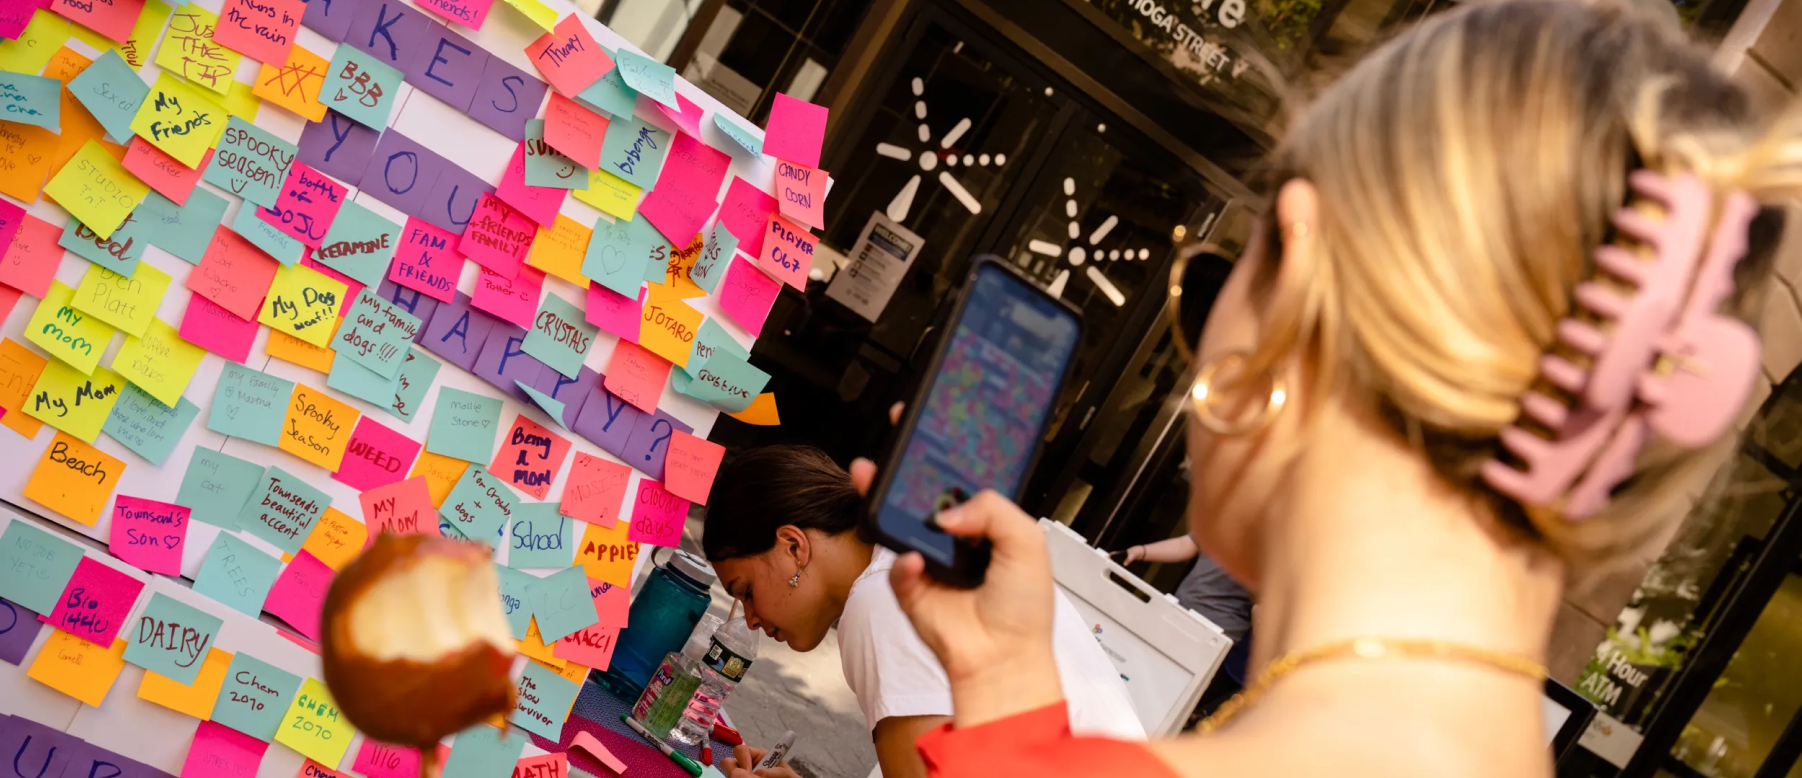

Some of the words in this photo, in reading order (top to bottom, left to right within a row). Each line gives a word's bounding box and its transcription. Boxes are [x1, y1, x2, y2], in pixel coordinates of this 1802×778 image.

[228, 7, 252, 30] the
[255, 25, 287, 46] rain
[282, 11, 295, 27] in
[538, 34, 585, 68] Therapy
[1172, 23, 1231, 72] STREET
[340, 61, 383, 107] BBB
[155, 91, 182, 115] My
[150, 110, 212, 142] Friends
[225, 127, 295, 172] SPOOKY
[78, 160, 134, 208] STUDIO
[218, 150, 284, 190] season!
[778, 162, 812, 187] CANDY
[785, 187, 812, 209] CORN
[316, 233, 391, 260] KETAMINE
[409, 229, 446, 250] FAM
[471, 230, 520, 257] FAMILY
[771, 220, 815, 256] PLAYER
[212, 251, 234, 268] Cat
[771, 246, 802, 272] 067
[399, 262, 454, 292] FRIENDS
[484, 278, 514, 297] Potter
[56, 305, 83, 327] My
[92, 282, 137, 320] Platt
[272, 295, 299, 322] My
[302, 287, 336, 308] Dog
[361, 294, 381, 314] My
[382, 306, 418, 340] family
[42, 323, 93, 356] mom
[357, 313, 386, 335] and
[536, 310, 590, 355] CRYSTALS
[644, 304, 694, 343] JOTARO
[35, 391, 68, 417] My
[75, 380, 117, 407] Mom
[295, 393, 341, 440] Spooky
[451, 415, 480, 428] Stone
[286, 418, 331, 457] Season
[512, 427, 552, 460] Being
[50, 442, 106, 486] Beach
[348, 437, 402, 475] WEED
[201, 479, 226, 494] cat
[513, 470, 552, 486] MOM
[261, 494, 313, 530] beautiful
[269, 477, 320, 515] Townsend's
[373, 497, 395, 520] MY
[117, 505, 184, 528] Townsend's
[260, 513, 300, 541] accent
[454, 502, 475, 524] dogs
[127, 528, 160, 547] Son
[512, 516, 565, 552] School
[216, 540, 255, 598] TREES
[66, 587, 100, 611] Bio
[138, 616, 210, 668] DAIRY
[235, 671, 280, 698] Chem
[522, 676, 538, 691] The
[1606, 651, 1649, 689] Hour
[229, 691, 265, 712] 2070
[1580, 671, 1624, 708] ATM
[298, 693, 340, 723] CHEM
[292, 715, 333, 741] 2070
